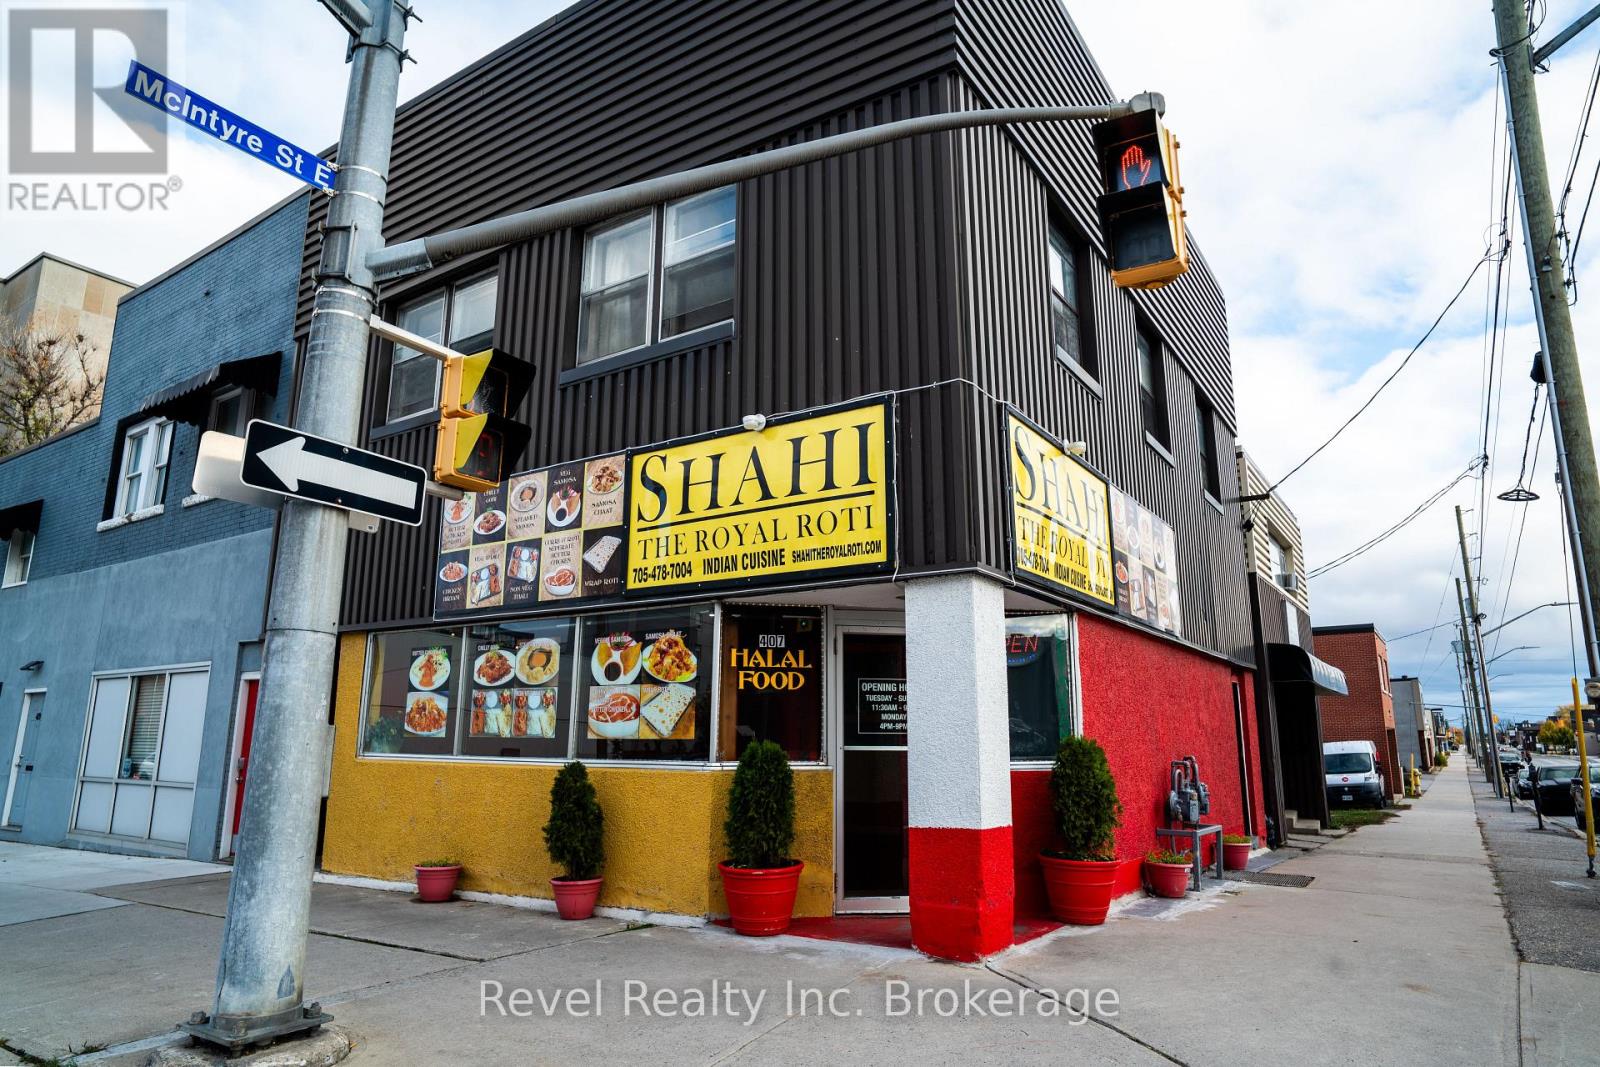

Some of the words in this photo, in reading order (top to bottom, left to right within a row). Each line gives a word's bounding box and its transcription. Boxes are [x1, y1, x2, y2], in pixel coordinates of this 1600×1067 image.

[134, 70, 264, 153] McIntyre
[275, 143, 304, 175] St
[313, 163, 332, 187] E
[637, 422, 877, 523] SHAHI
[1014, 425, 1109, 547] SHAHI
[638, 532, 688, 560] THE
[694, 518, 787, 553] ROYAL
[797, 505, 873, 538] ROTI
[1018, 516, 1048, 550] THE
[633, 561, 692, 584] 705-478-7004
[703, 553, 738, 576] INDIAN
[741, 548, 786, 571] CUISINE
[792, 540, 882, 564] SHAHITHEROYALROTI.COM
[731, 648, 812, 668] HALAL
[759, 634, 785, 648] 407
[1006, 634, 1038, 653] EN
[738, 671, 805, 690] FOOD
[861, 682, 897, 692] OPENING
